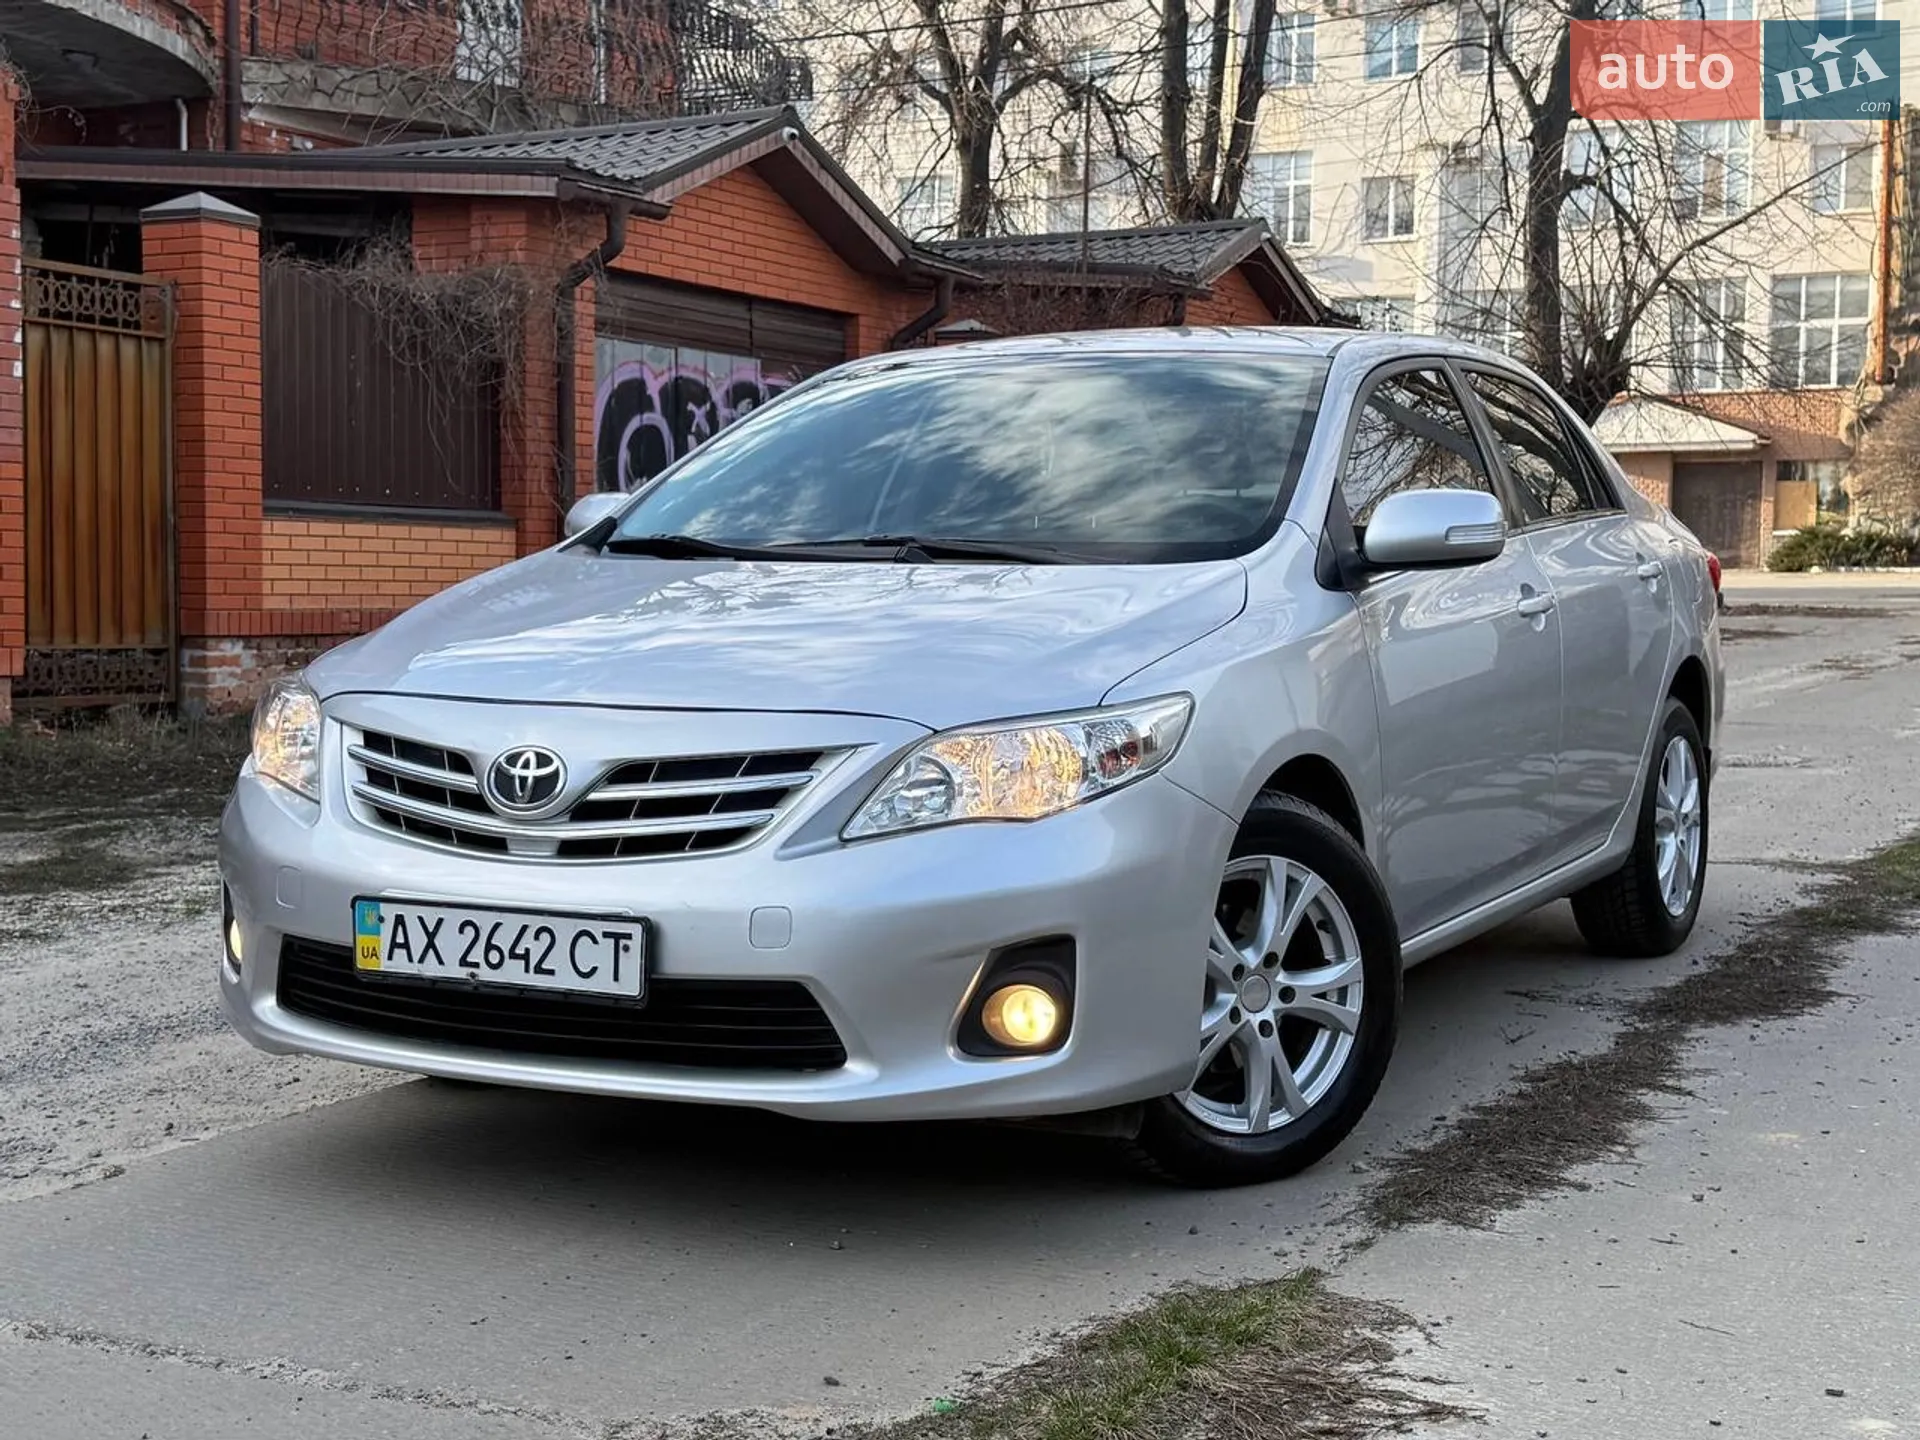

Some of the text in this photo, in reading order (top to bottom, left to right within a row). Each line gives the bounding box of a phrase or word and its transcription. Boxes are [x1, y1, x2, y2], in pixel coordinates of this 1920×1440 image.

[361, 945, 379, 960] UA
[387, 913, 633, 982] AX 2642 CT
